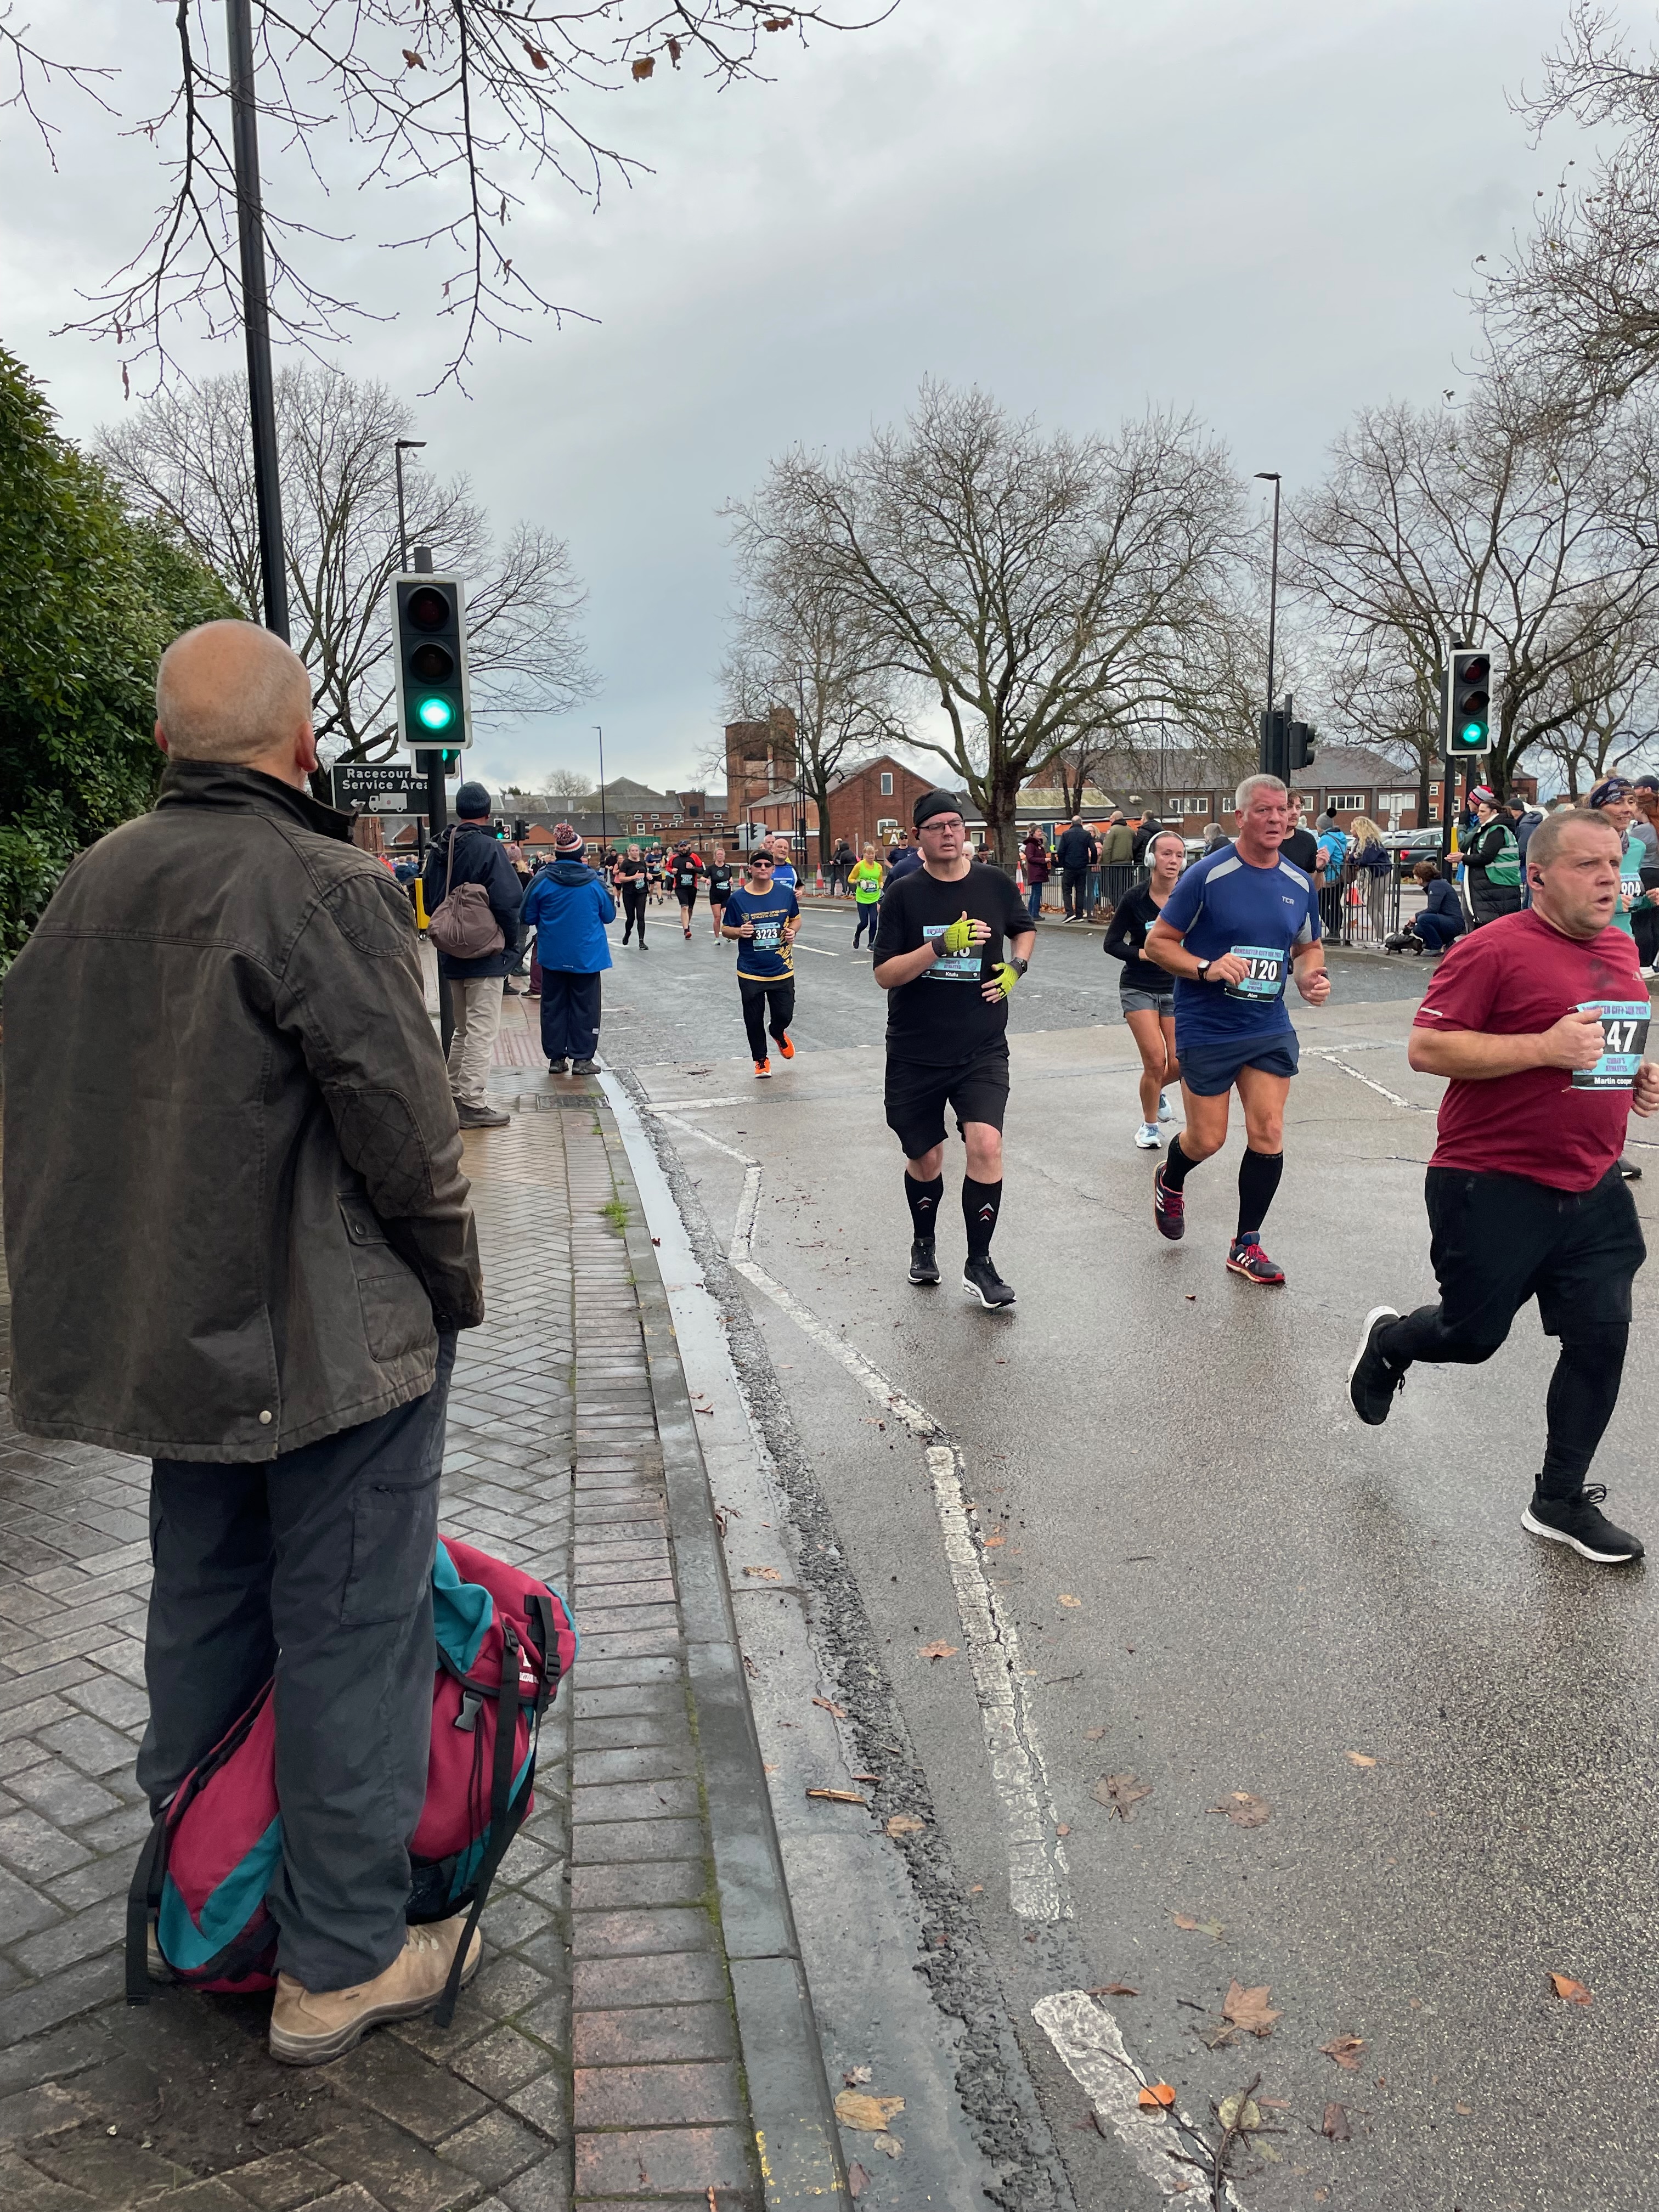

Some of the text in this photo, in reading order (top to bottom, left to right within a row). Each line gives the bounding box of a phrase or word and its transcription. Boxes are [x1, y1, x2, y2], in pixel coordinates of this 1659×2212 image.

[347, 769, 411, 778] Racecour
[342, 780, 393, 790] Service
[889, 833, 899, 844] A
[755, 928, 778, 940] 3223
[1242, 958, 1278, 981] 120
[1597, 1021, 1638, 1052] 47
